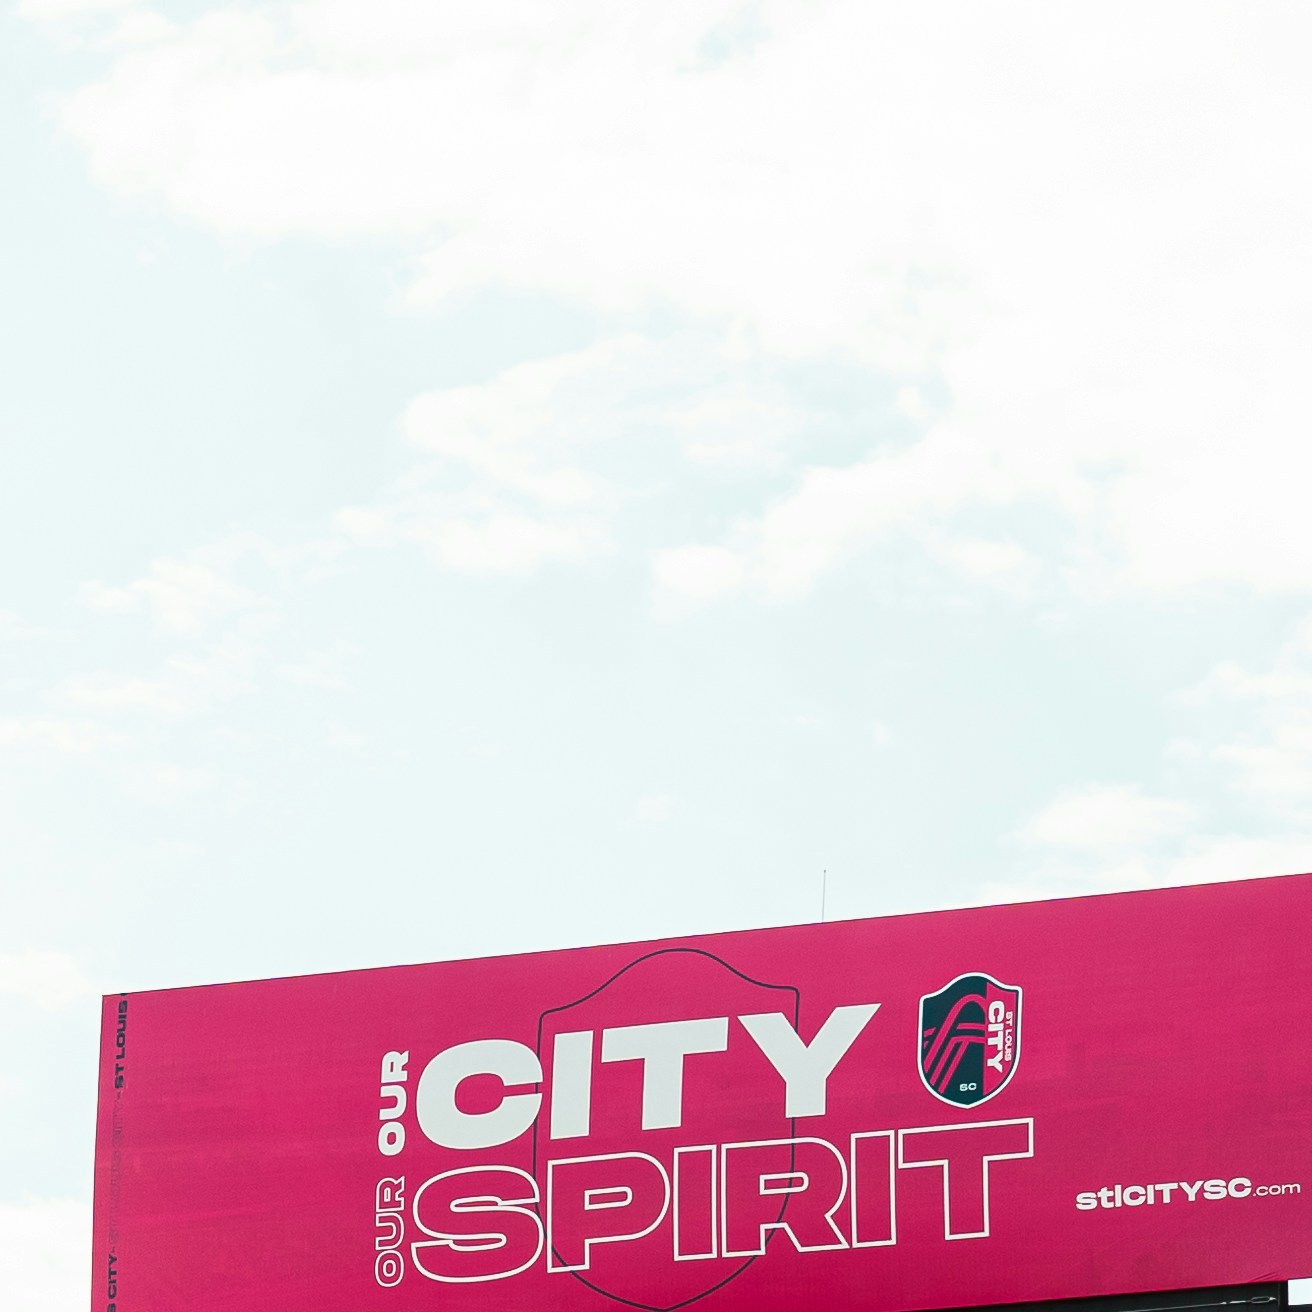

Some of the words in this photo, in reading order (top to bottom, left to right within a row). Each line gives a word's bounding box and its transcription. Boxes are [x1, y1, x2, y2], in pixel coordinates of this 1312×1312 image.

[115, 999, 128, 1060] LOUIS
[986, 1000, 1005, 1073] CITY
[1004, 1010, 1014, 1027] ST
[1004, 1028, 1013, 1062] LOUIS
[114, 1063, 125, 1089] ST
[377, 1050, 409, 1156] OUR
[416, 1002, 883, 1150] CITY
[959, 1082, 978, 1092] SC
[374, 1175, 405, 1288] OUR
[410, 1117, 1034, 1283] SPIRIT
